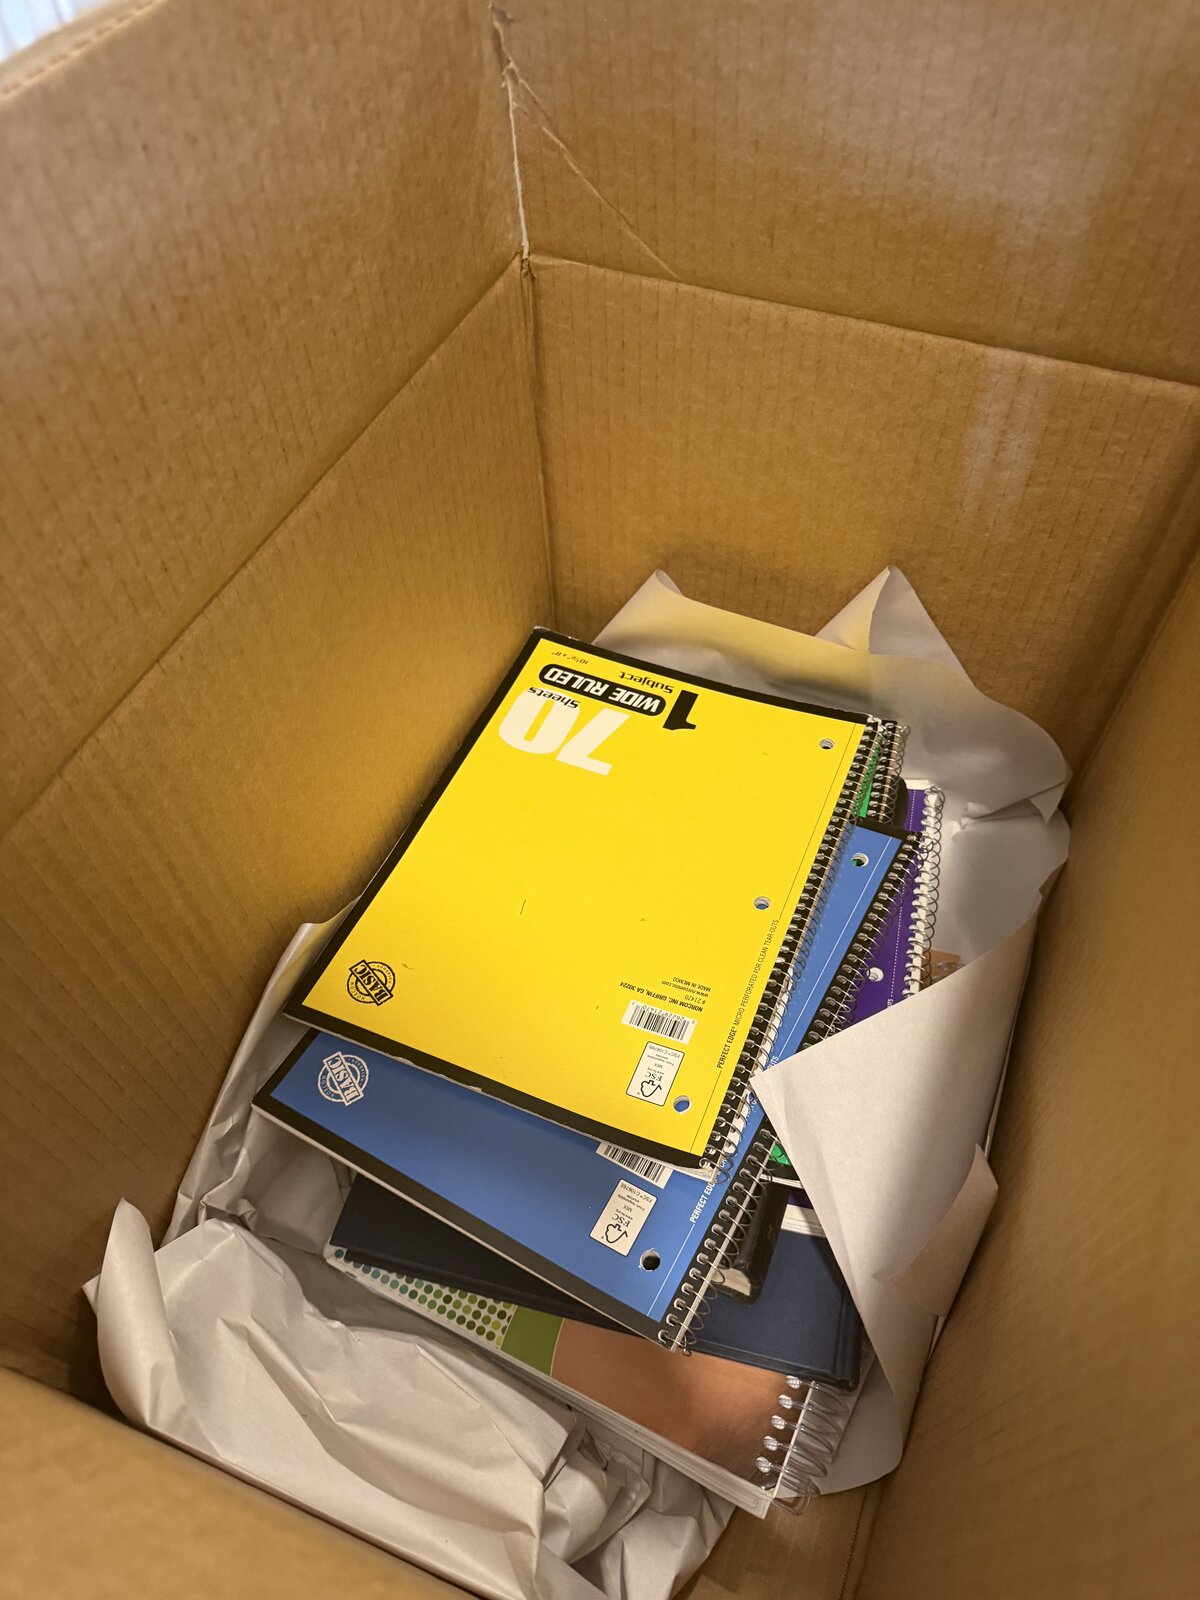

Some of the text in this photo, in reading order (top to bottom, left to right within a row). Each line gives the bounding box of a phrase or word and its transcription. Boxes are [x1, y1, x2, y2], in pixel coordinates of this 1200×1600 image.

[543, 667, 661, 713] WIDE RULED
[618, 671, 699, 731] 1 Subject
[498, 686, 631, 776] 70 Sheets
[764, 919, 779, 949] TEAR-OUTS
[757, 946, 768, 965] CLEAN
[754, 961, 762, 975] FOR
[354, 964, 388, 1002] BASIC
[620, 981, 636, 990] 30224
[673, 977, 691, 986] MEXICO
[697, 984, 711, 993] MADE
[740, 973, 758, 1008] PERFORATED
[646, 989, 667, 1001] GRIFFIN,
[669, 997, 679, 1005] INC.
[684, 995, 701, 1004] 21470
[679, 1001, 703, 1012] NORCOM
[733, 1006, 745, 1026] MICRO
[717, 1040, 731, 1069] PERFECT
[329, 1056, 359, 1101] BASIC
[645, 1071, 663, 1081] FSC
[321, 1075, 335, 1098] NORCOM
[689, 1194, 708, 1223] PERFECT
[612, 1213, 631, 1227] FSC
